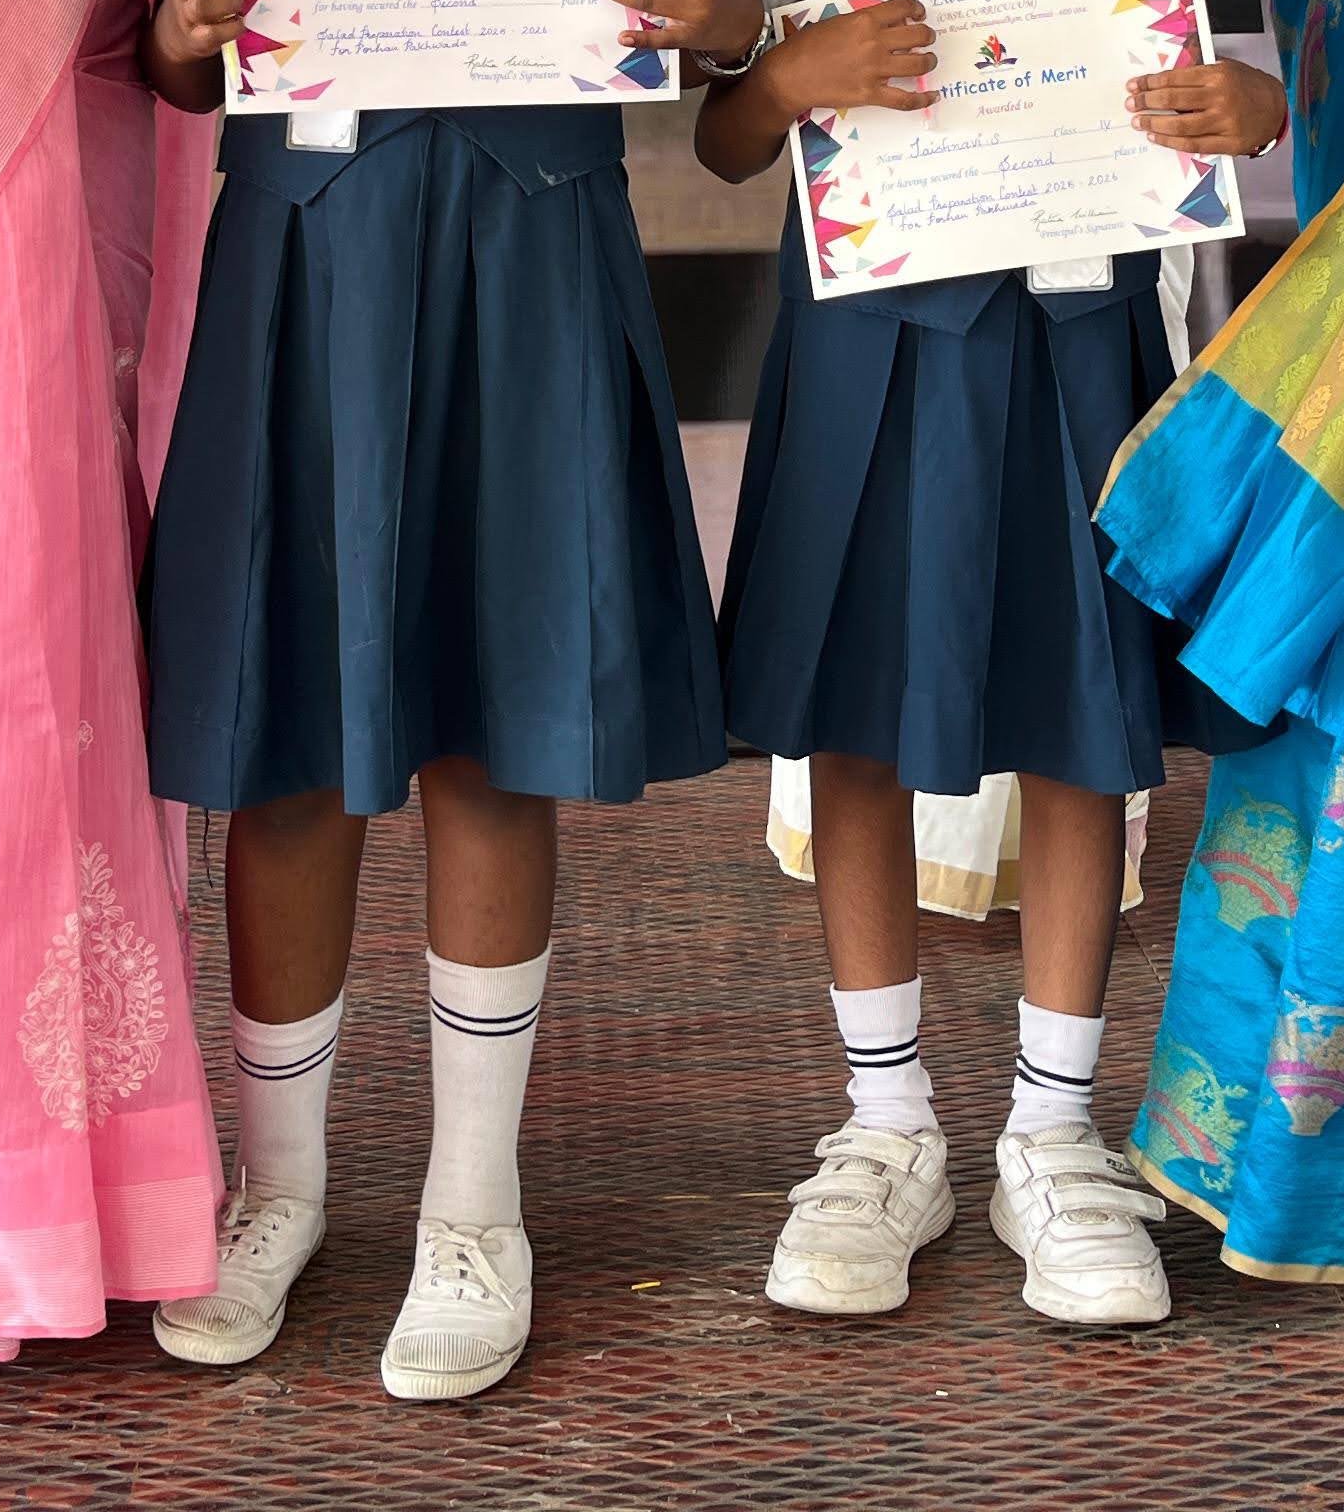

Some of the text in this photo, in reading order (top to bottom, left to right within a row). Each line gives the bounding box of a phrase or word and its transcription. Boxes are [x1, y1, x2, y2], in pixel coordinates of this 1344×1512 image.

[331, 0, 364, 14] having
[366, 0, 400, 10] secured
[940, 76, 1006, 99] tificate
[1014, 71, 1032, 88] of
[1042, 65, 1087, 84] Merit
[977, 100, 1034, 118] Awarded to
[965, 166, 979, 177] the
[1113, 146, 1137, 160] place
